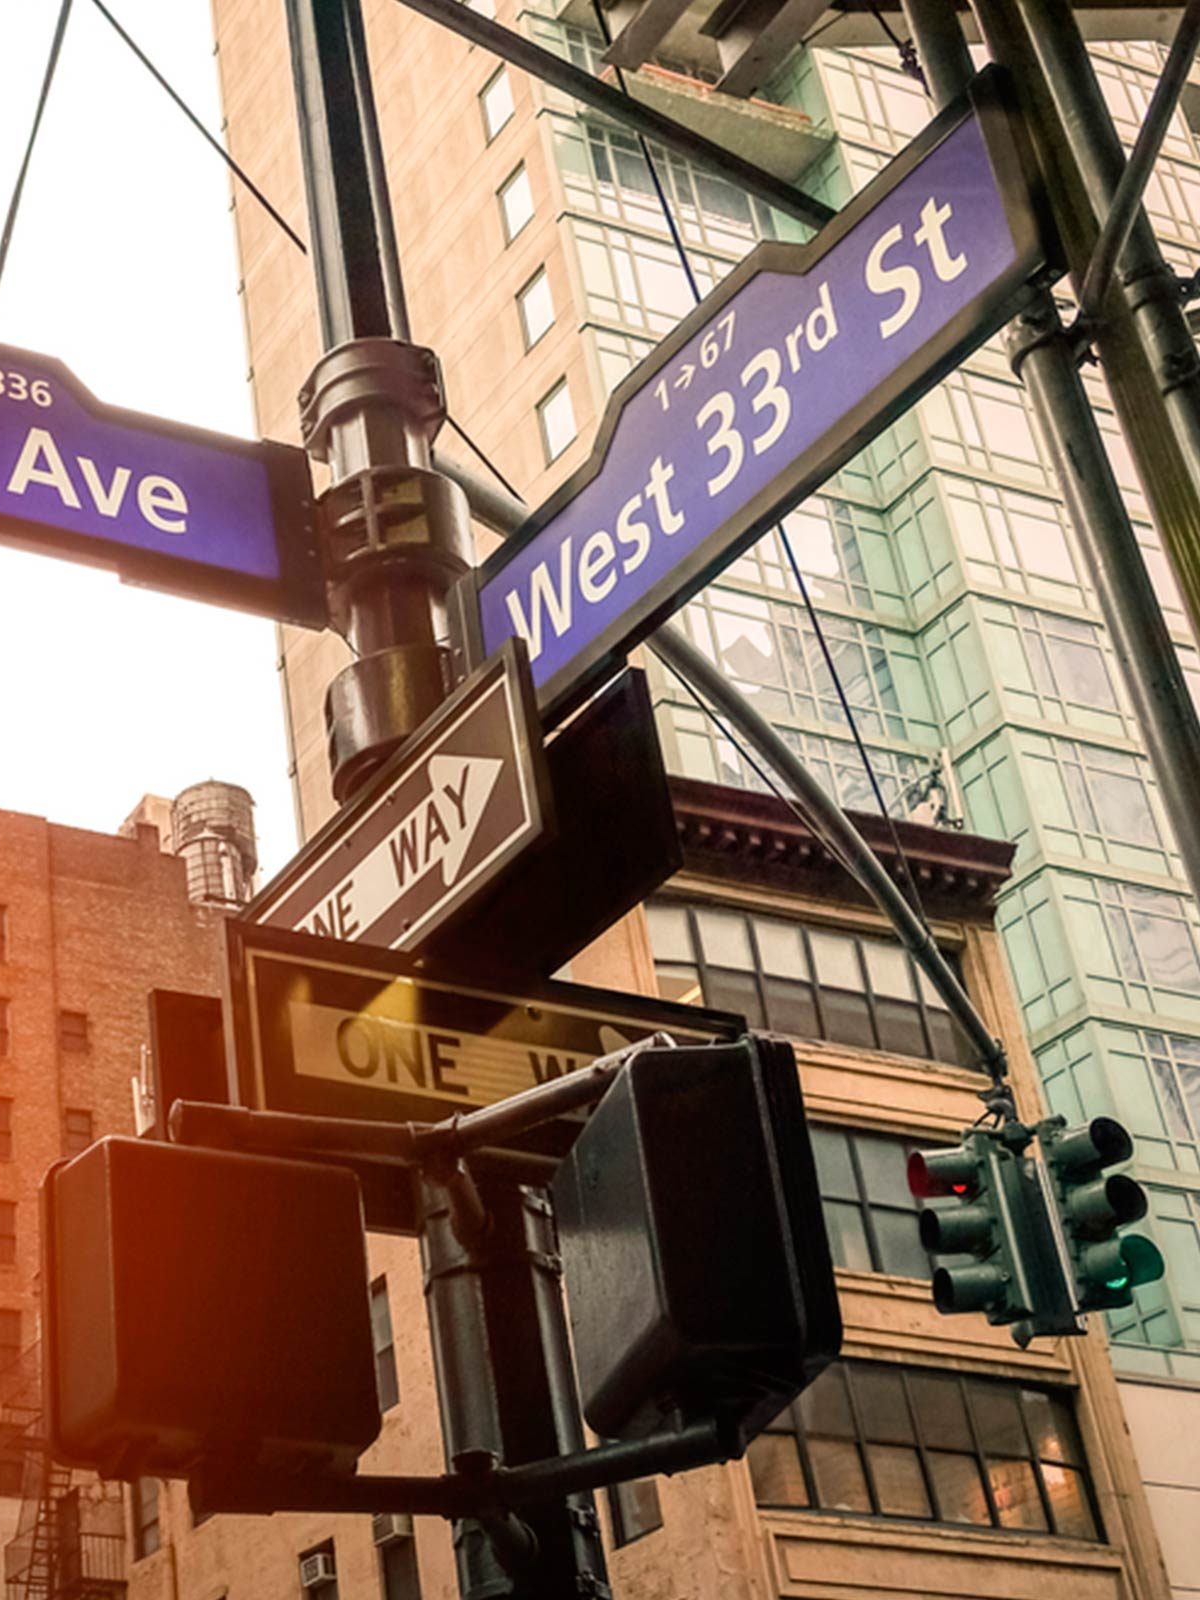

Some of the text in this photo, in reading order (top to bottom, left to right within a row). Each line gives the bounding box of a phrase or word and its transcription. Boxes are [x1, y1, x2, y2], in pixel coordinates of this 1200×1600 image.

[654, 310, 736, 412] 1 67
[7, 427, 188, 535] Ave
[505, 197, 968, 663] West 33rd St
[299, 764, 471, 939] NE WAY
[335, 1016, 469, 1095] ONE
